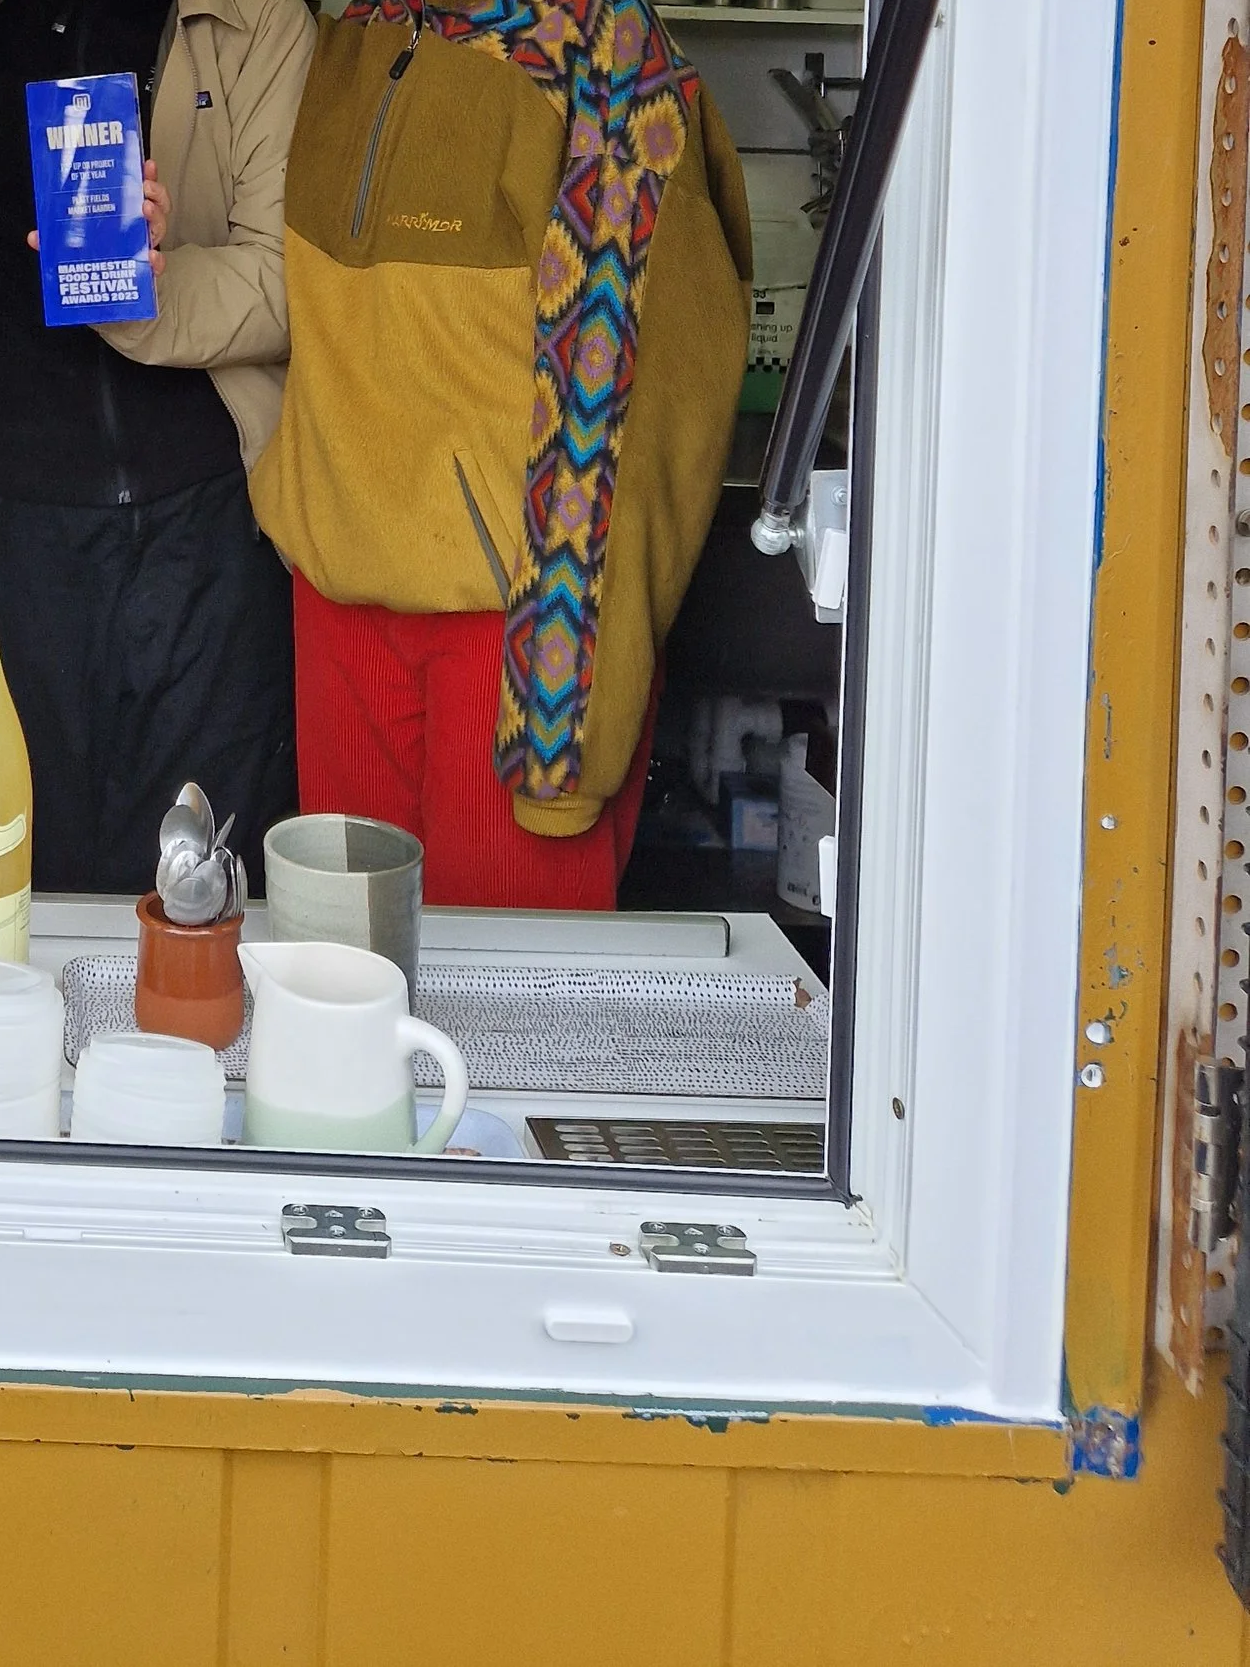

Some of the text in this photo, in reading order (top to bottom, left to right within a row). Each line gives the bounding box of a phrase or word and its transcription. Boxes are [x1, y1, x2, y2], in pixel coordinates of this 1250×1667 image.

[46, 121, 123, 150] WINNER
[90, 159, 114, 168] PROJECT
[71, 172, 78, 180] OF
[92, 170, 106, 179] YEAR
[90, 194, 110, 202] FIELDS
[92, 203, 116, 213] GARDEN
[58, 260, 136, 274] MANCHESTER
[59, 270, 136, 282] FOOD & DRINK
[60, 279, 138, 295] FESTIVAL
[62, 291, 139, 305] AWARDS 2023
[780, 325, 793, 333] up
[752, 333, 778, 344] liquid
